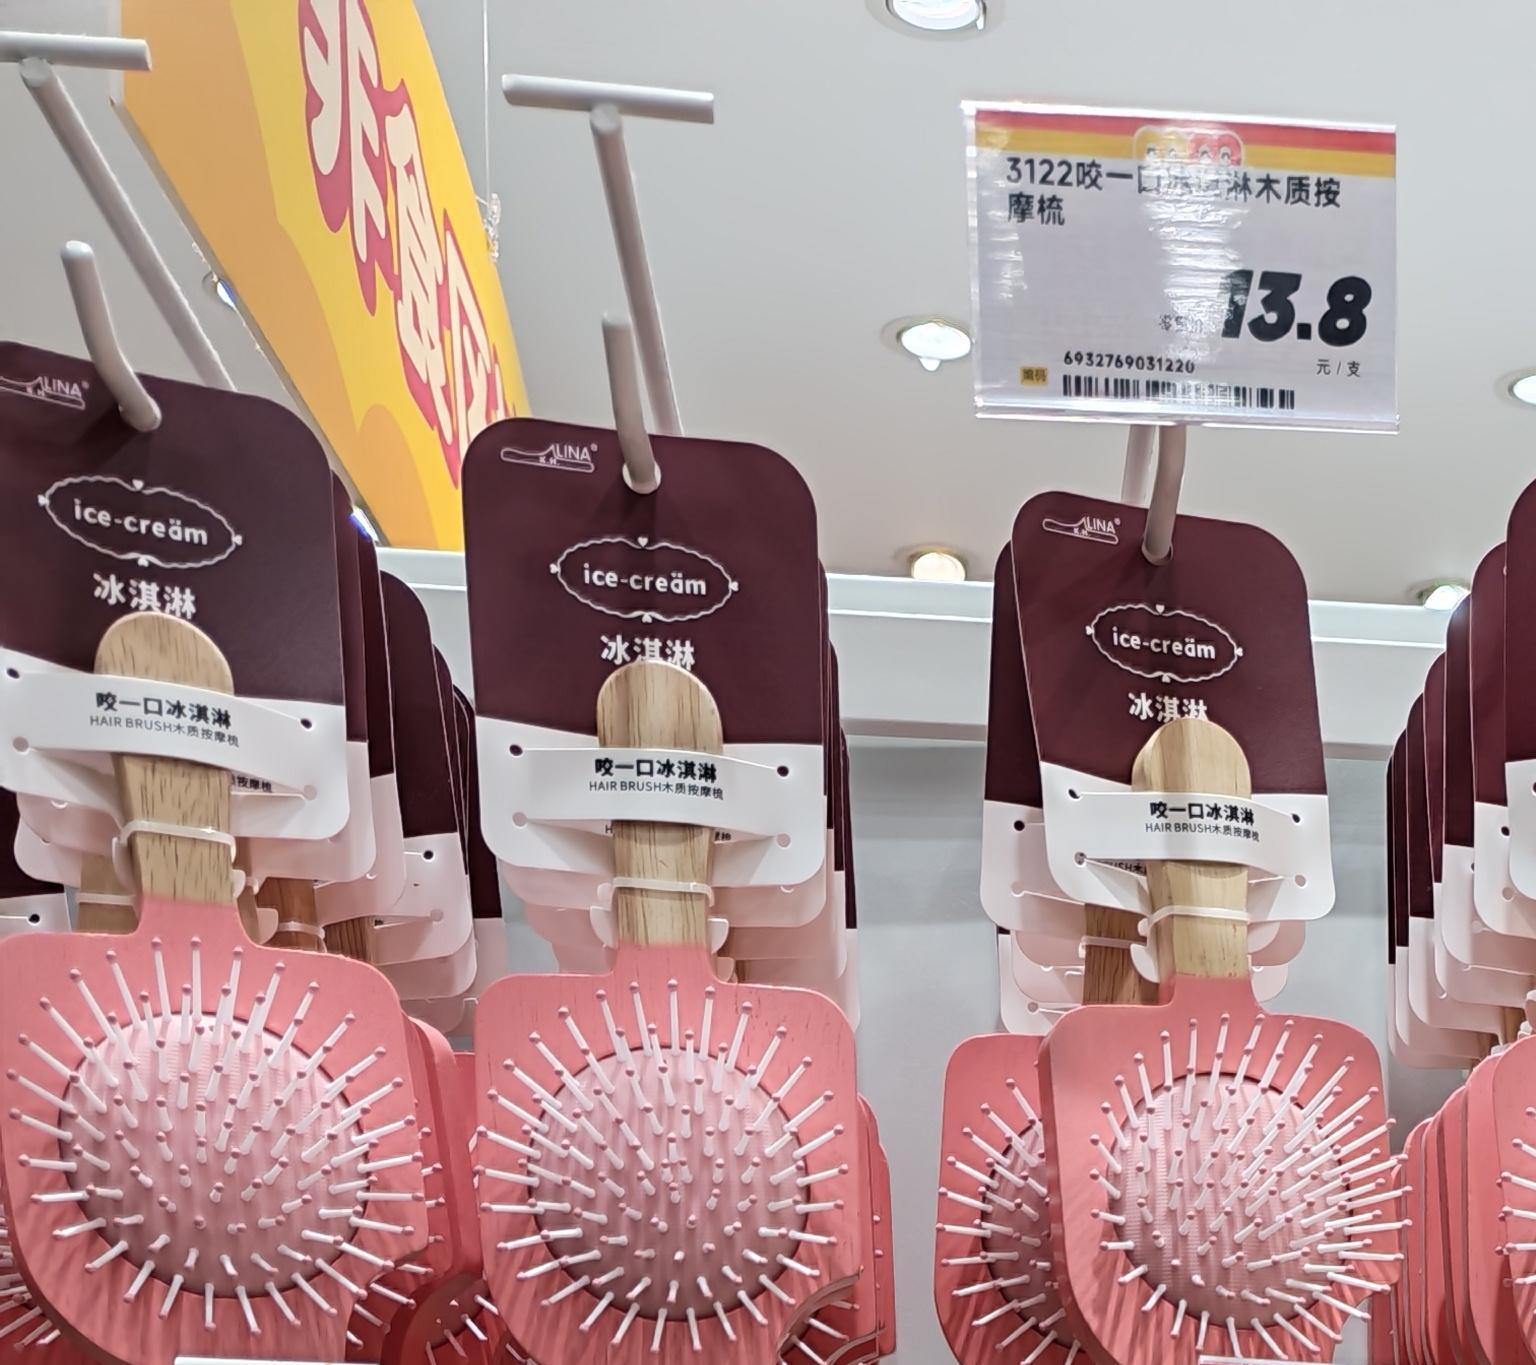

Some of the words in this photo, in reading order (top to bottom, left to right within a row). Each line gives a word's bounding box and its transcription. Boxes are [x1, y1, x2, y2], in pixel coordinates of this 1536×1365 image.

[1007, 192, 1065, 226] 摩梳
[1221, 269, 1372, 347] 13.8
[1063, 350, 1195, 374] 6932769031220
[73, 498, 208, 546] ice-creäm
[93, 572, 197, 620] 冰淇淋
[583, 563, 707, 596] ice-creäm
[600, 634, 696, 671] 冰淇淋
[1112, 626, 1217, 660] ice-creäm
[89, 715, 122, 728] HAIR
[95, 691, 231, 729] 咬一口冰淇淋
[1128, 692, 1208, 722] 冰淇淋
[589, 780, 617, 792] HAIR
[594, 757, 718, 783] 咬一口冰淇淋
[1145, 823, 1172, 834] HAIR
[1150, 800, 1255, 827] 咬一口冰淇淋
